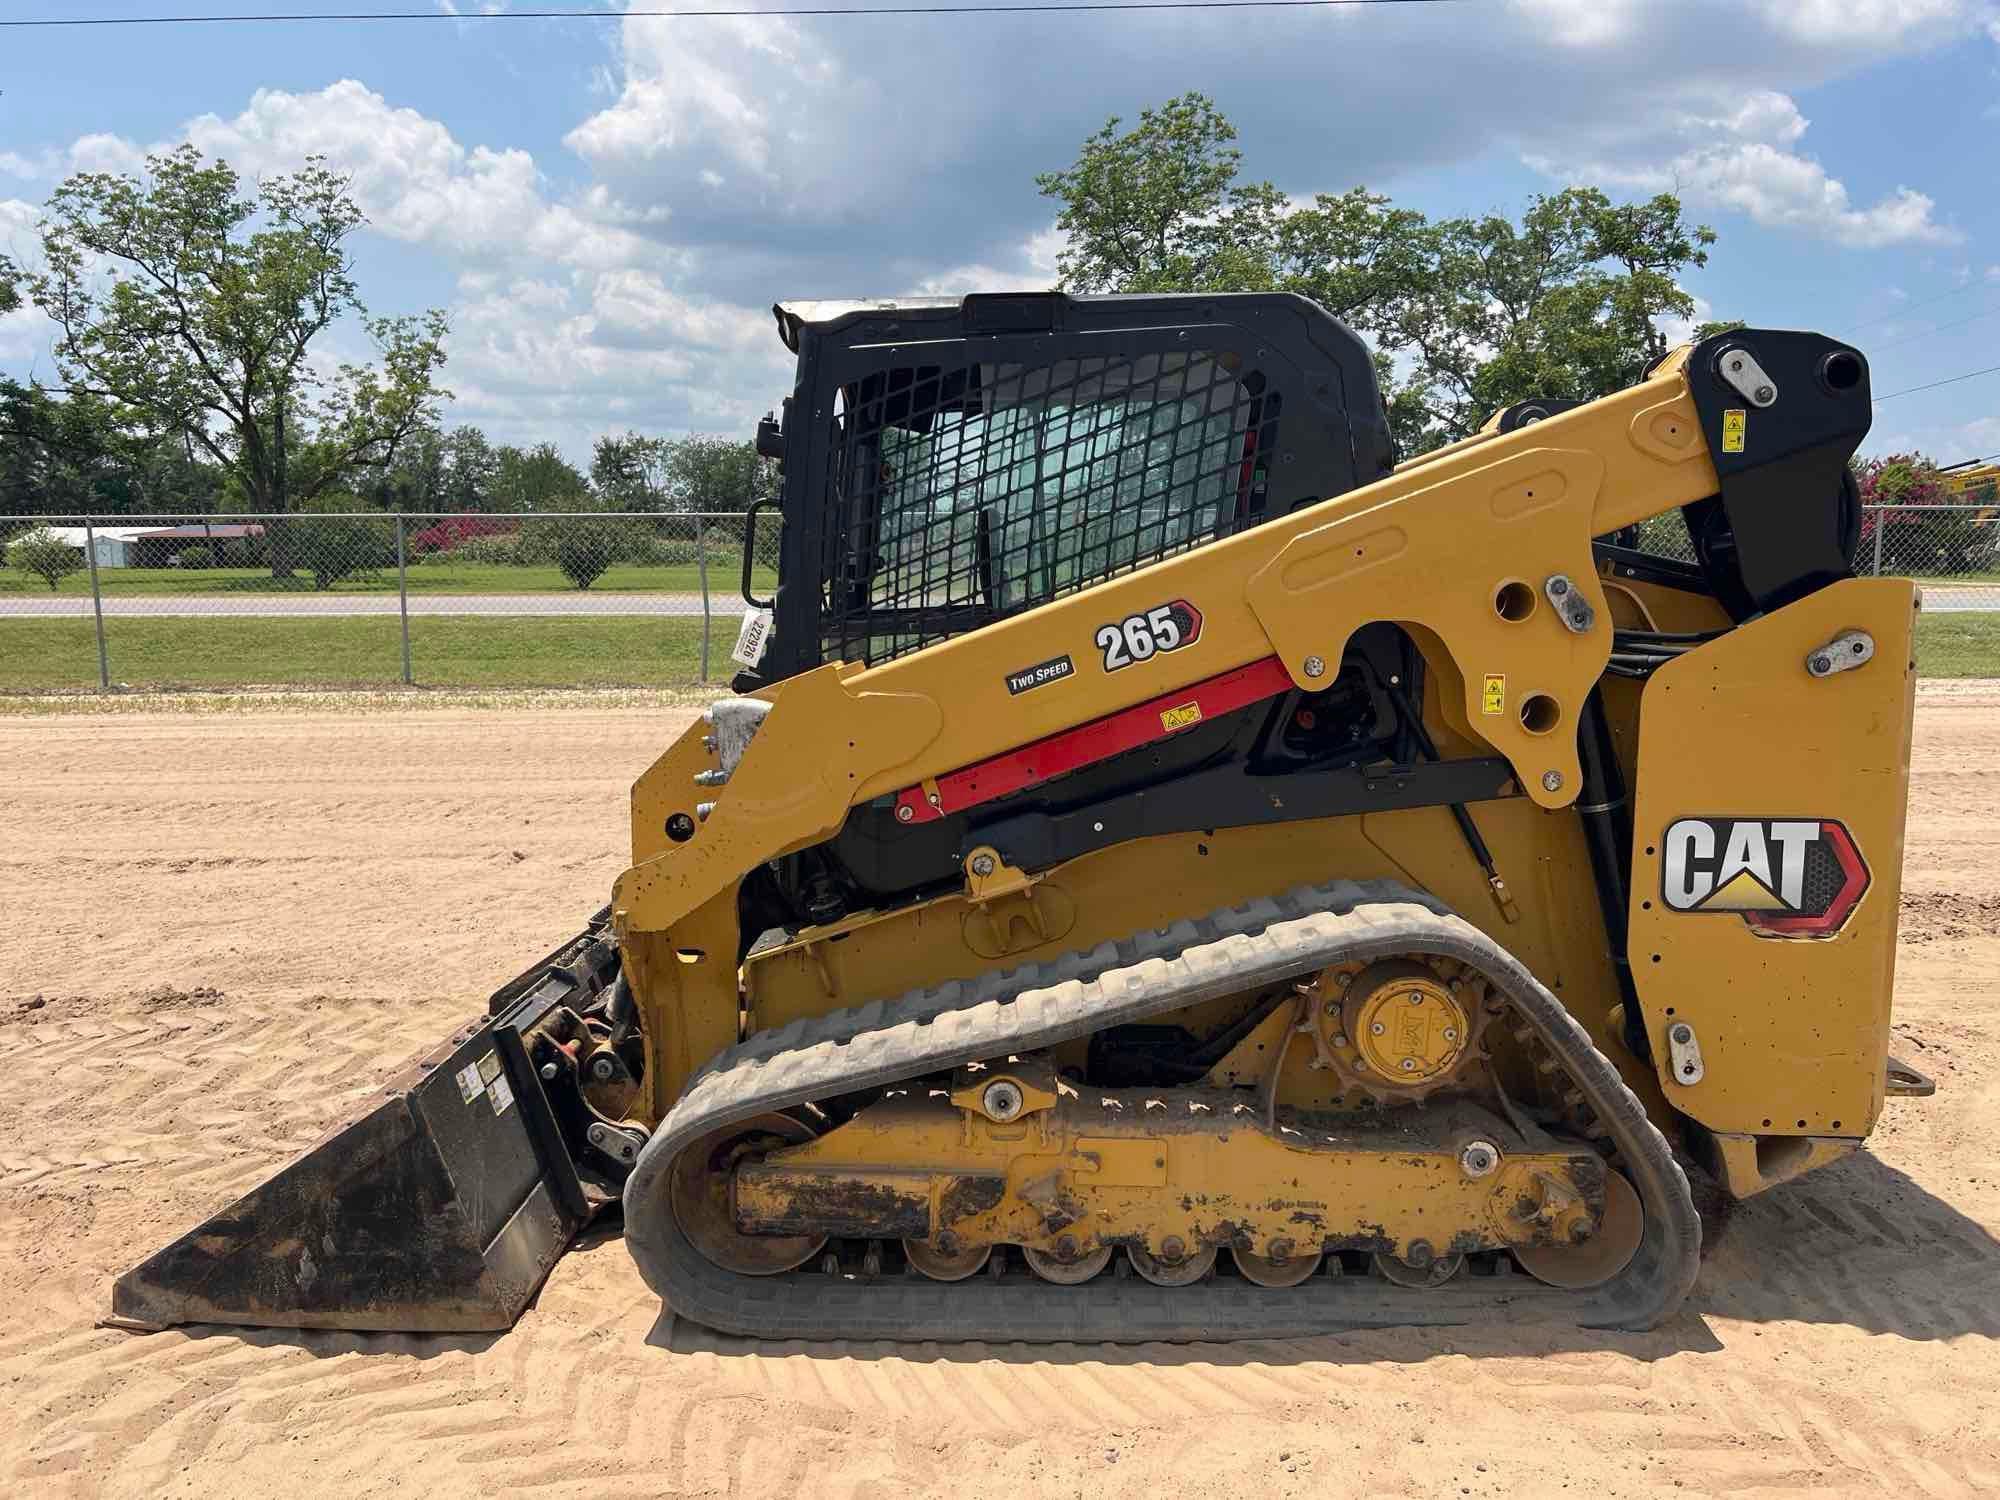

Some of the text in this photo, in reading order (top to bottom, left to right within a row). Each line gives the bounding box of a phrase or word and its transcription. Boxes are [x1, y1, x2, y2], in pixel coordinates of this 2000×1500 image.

[743, 620, 764, 659] 222926
[1097, 606, 1180, 670] 265
[1011, 662, 1068, 690] TWO SPEED
[1664, 820, 1820, 910] CAT
